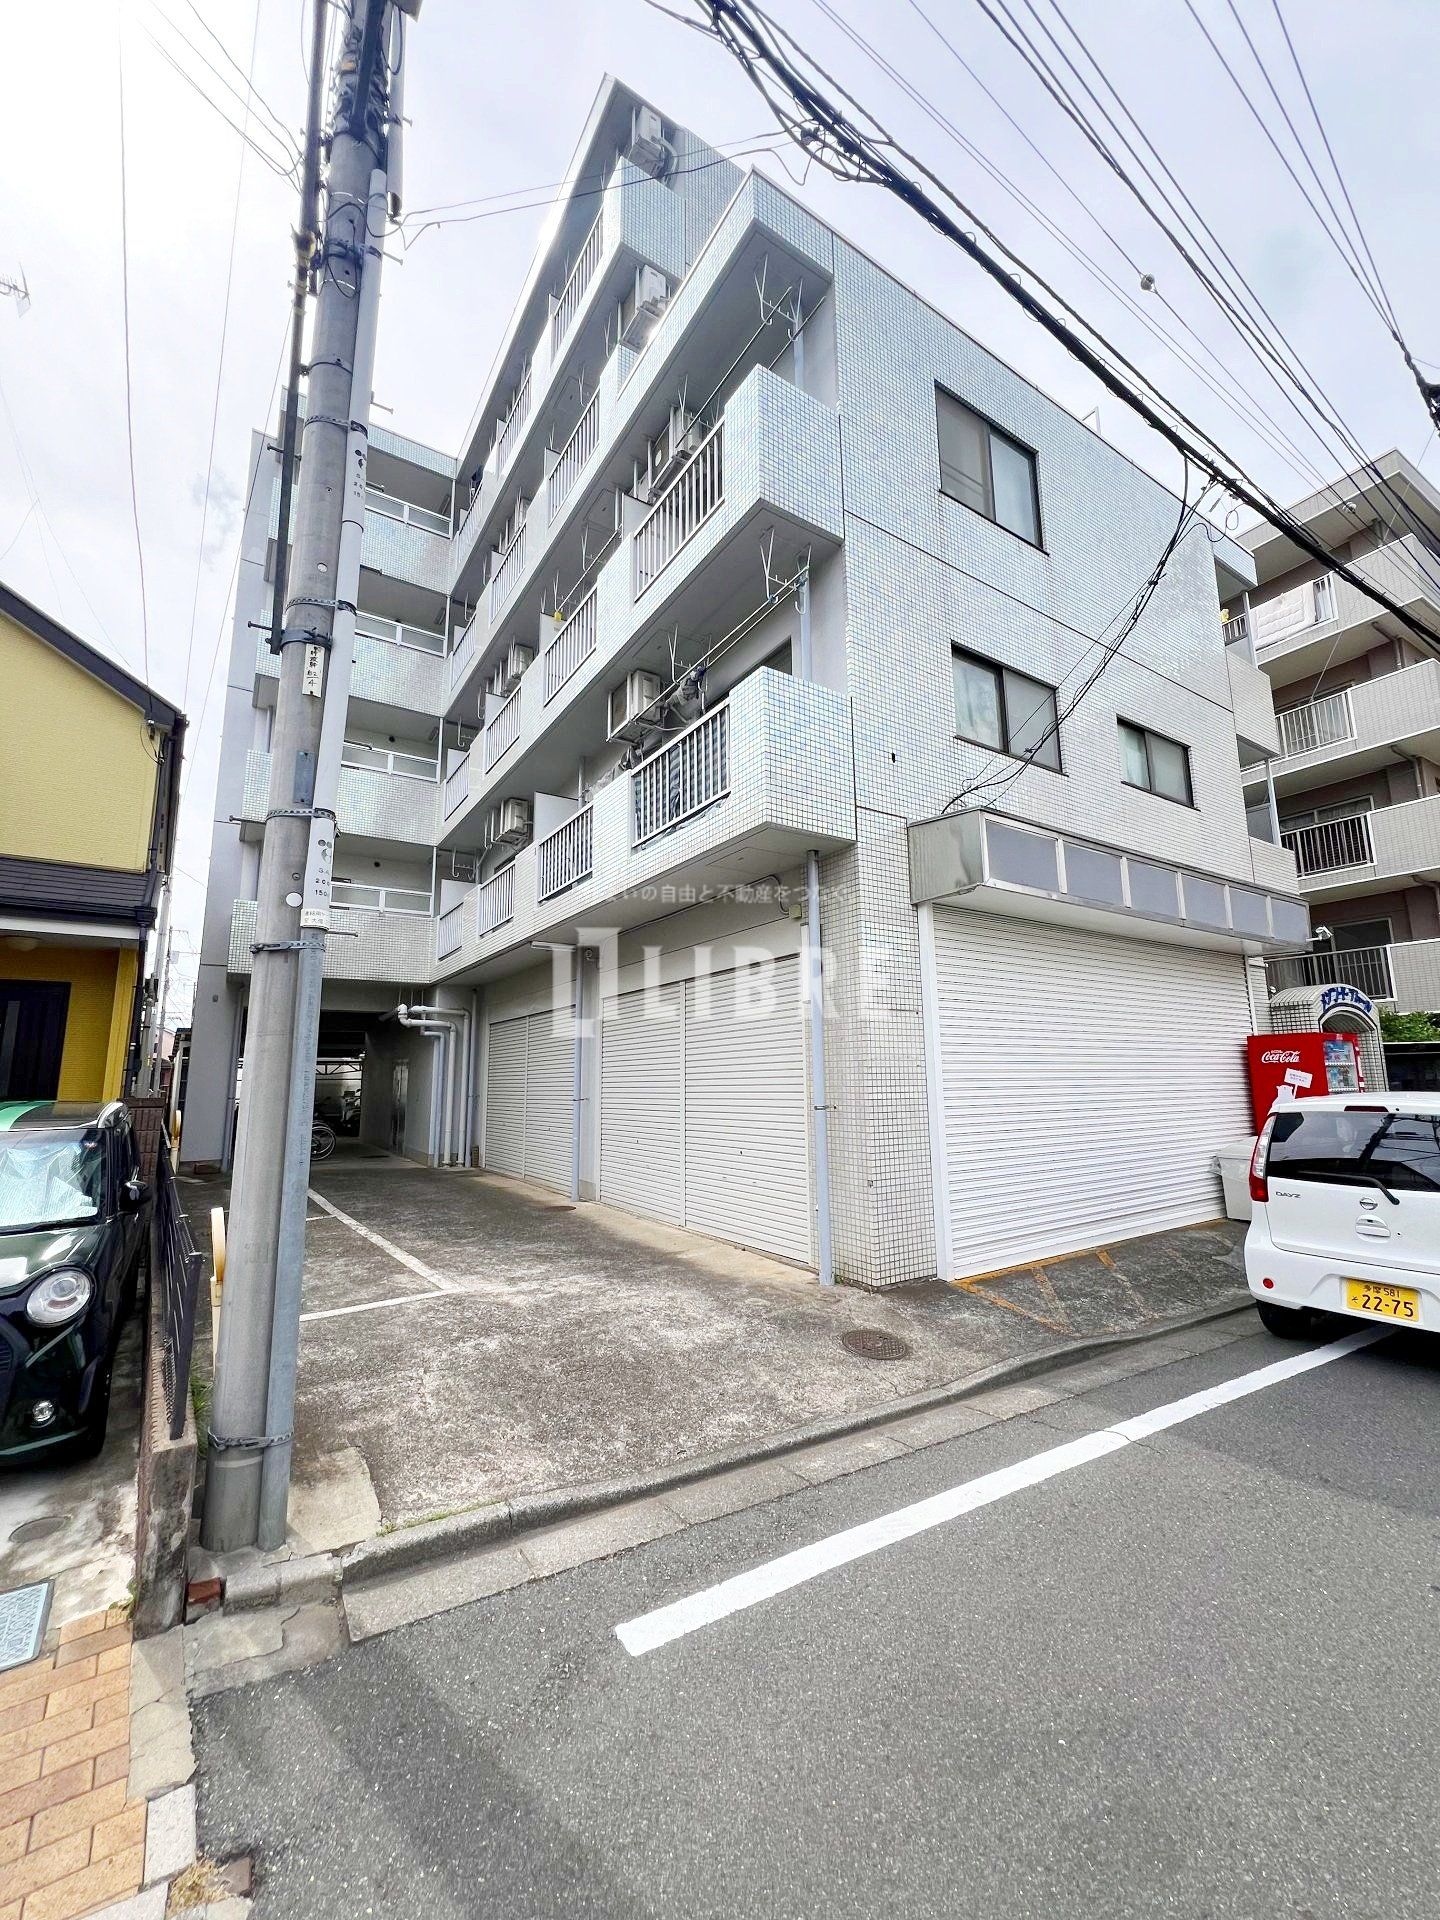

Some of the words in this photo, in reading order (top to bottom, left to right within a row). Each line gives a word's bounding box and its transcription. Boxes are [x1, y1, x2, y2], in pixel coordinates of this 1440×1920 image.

[1275, 1191, 1301, 1199] DAYZ
[1384, 1287, 1400, 1298] 581
[1361, 1294, 1414, 1318] 22-75
